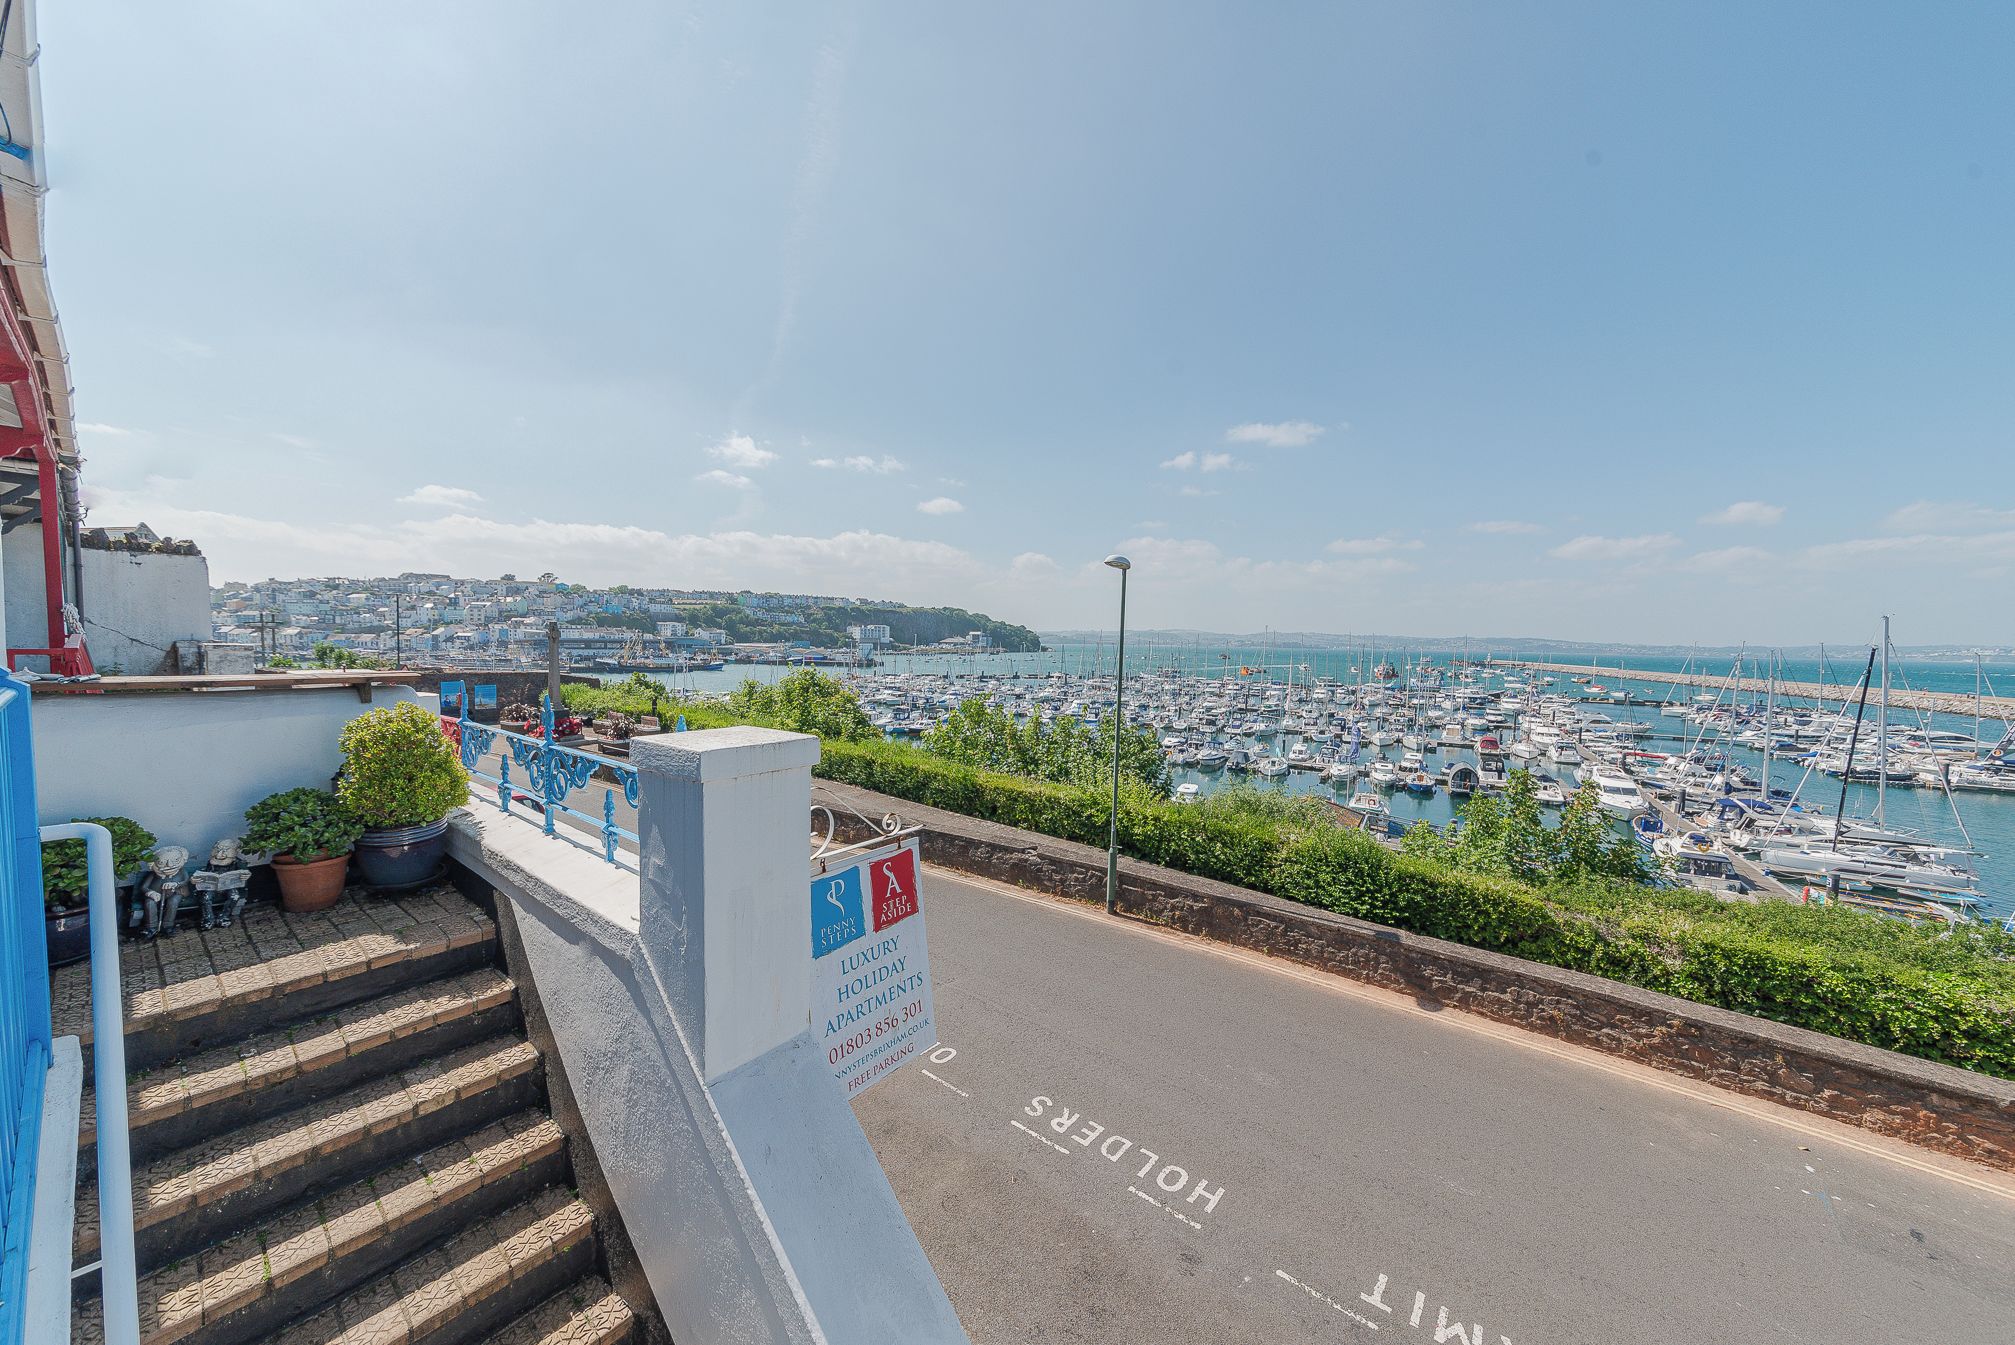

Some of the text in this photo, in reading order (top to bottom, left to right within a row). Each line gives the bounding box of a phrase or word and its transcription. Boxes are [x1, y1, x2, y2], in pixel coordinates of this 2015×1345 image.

[821, 916, 856, 938] PENNY
[880, 903, 912, 923] ASIDE
[882, 895, 907, 913] STEP
[821, 926, 857, 948] STEPS
[841, 935, 899, 975] LUXURY
[837, 956, 906, 1004] HOLIDAY
[824, 971, 923, 1038] APARTMENTS
[829, 999, 923, 1065] 01803 856 301
[848, 1042, 915, 1093] FREE PARKING
[1024, 1095, 1226, 1214] HOLDERS
[1360, 1273, 1511, 1345] MIT
